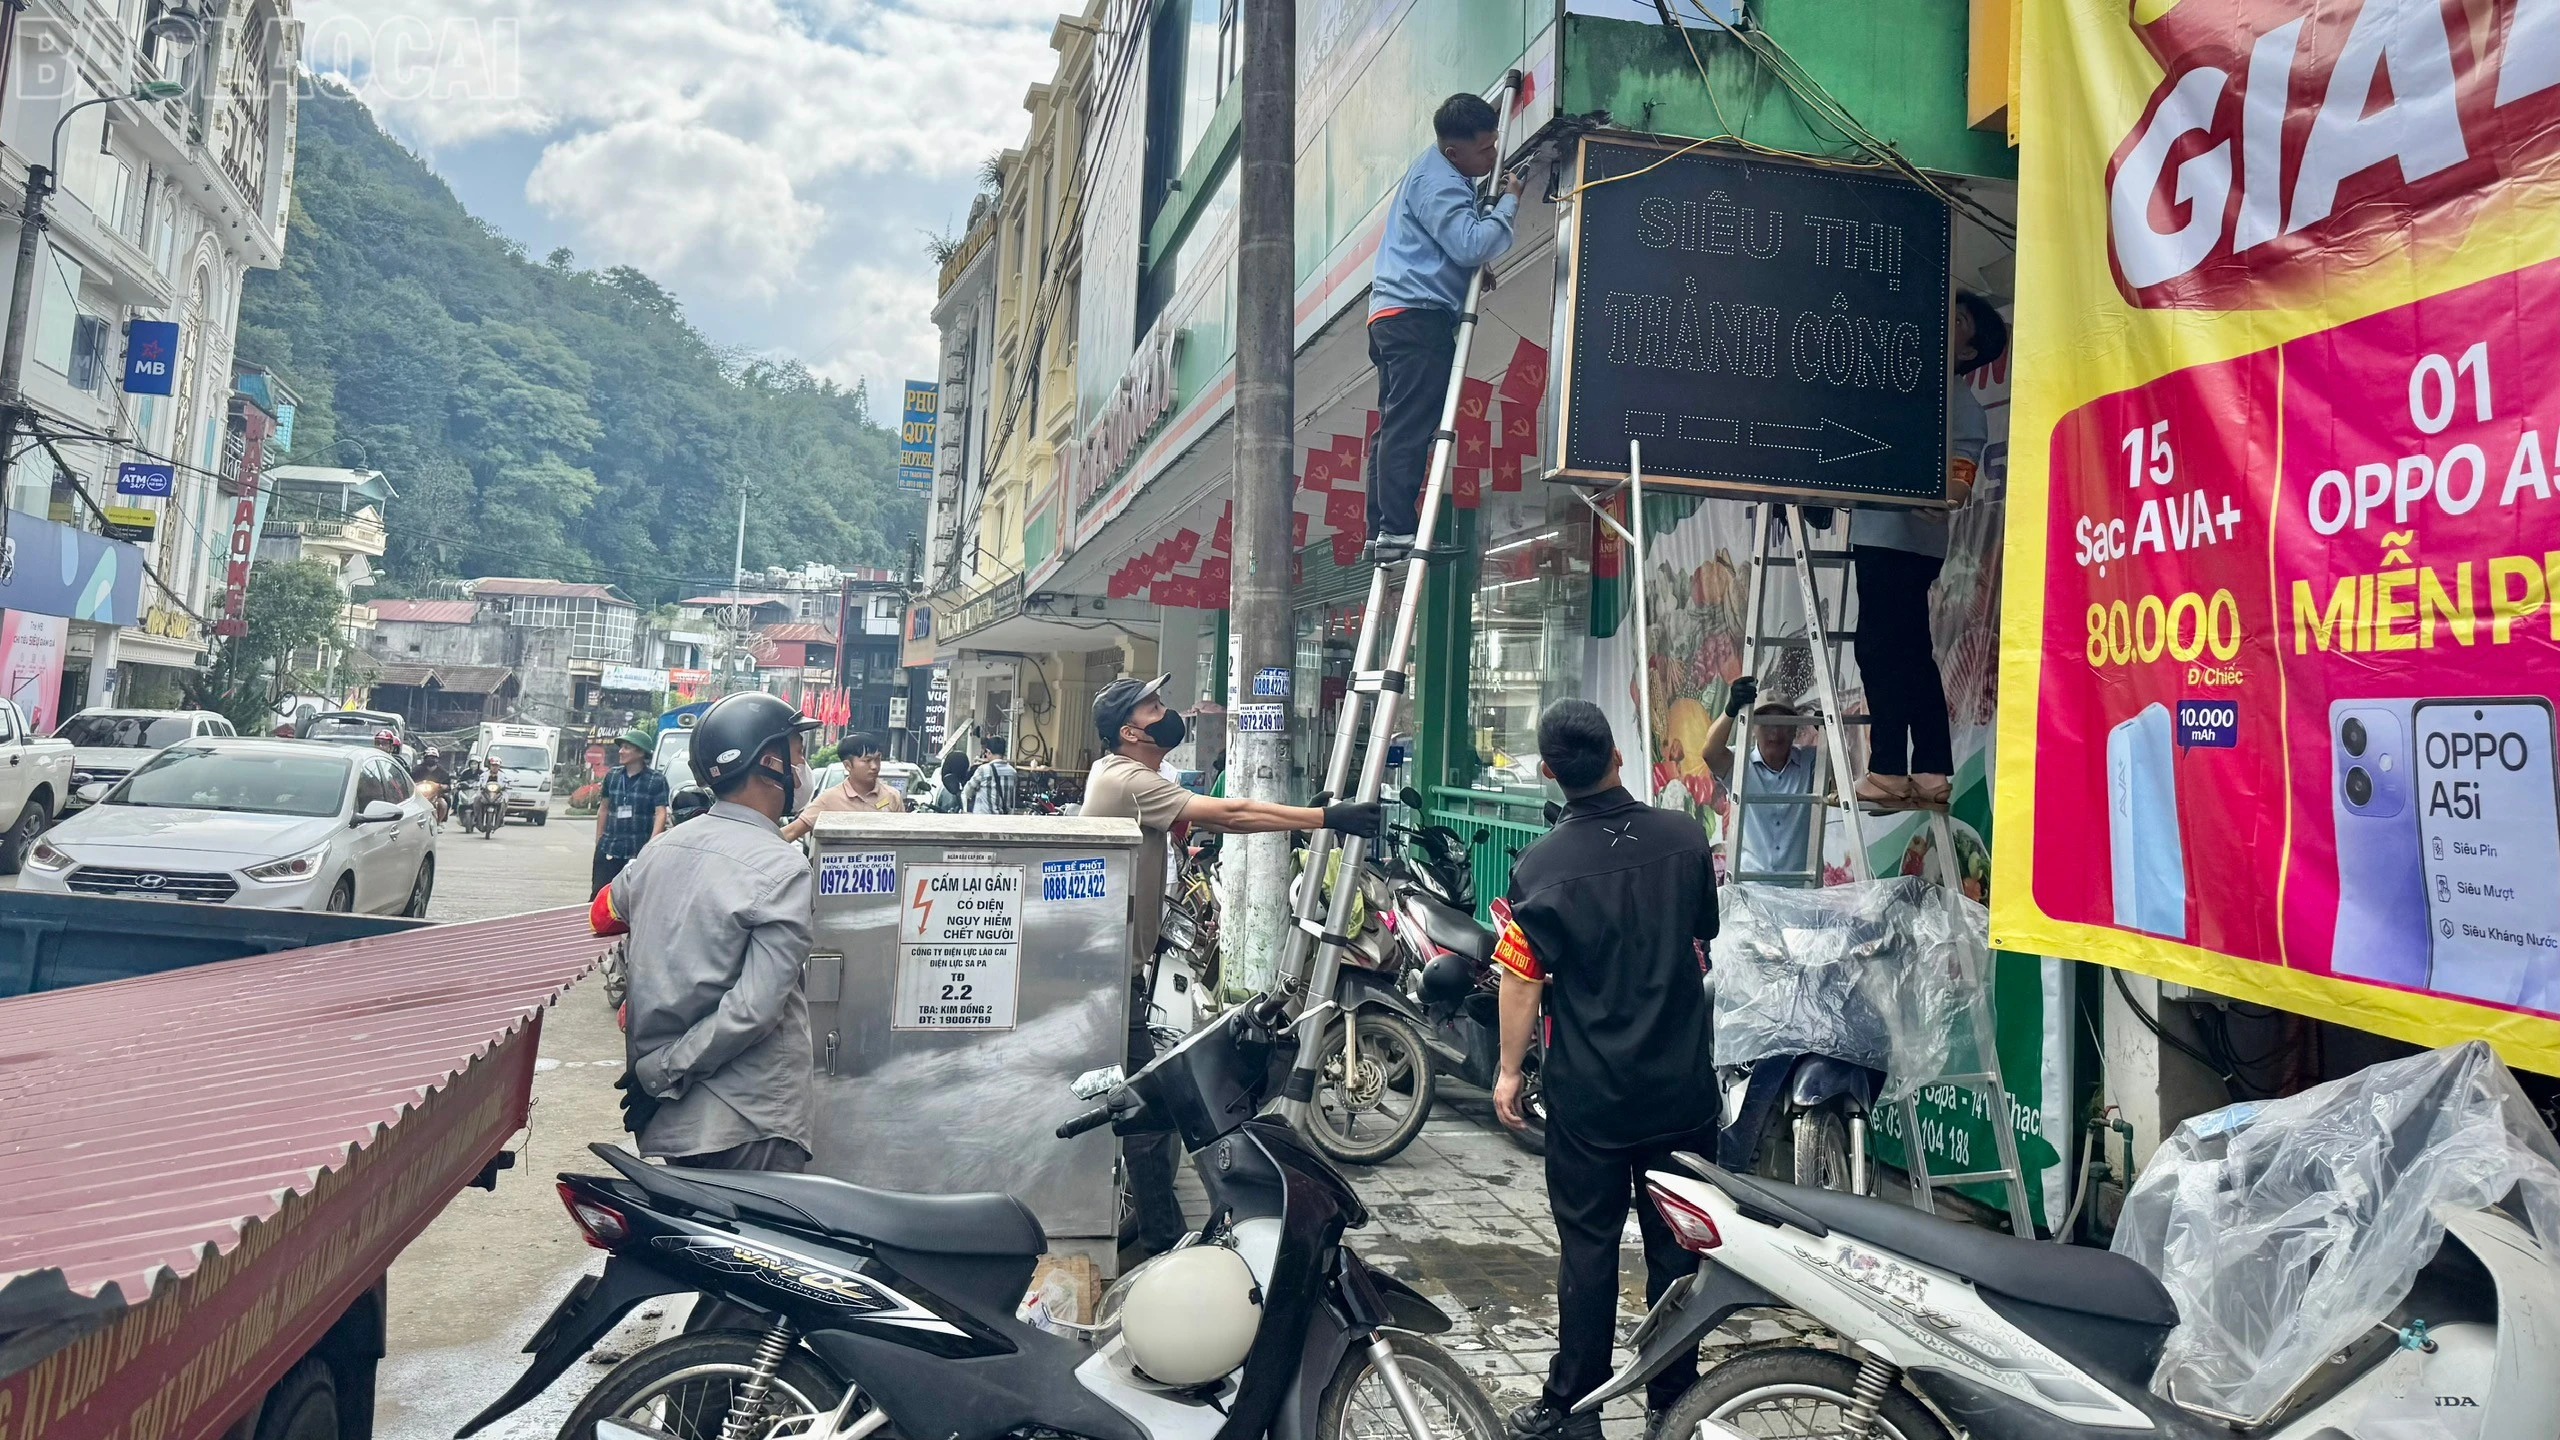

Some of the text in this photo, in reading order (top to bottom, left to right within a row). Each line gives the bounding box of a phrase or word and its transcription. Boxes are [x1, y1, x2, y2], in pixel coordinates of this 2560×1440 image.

[1637, 190, 1902, 292] SIÊU THỊ
[1790, 292, 1923, 392] CÔNG
[135, 360, 165, 376] MB
[2408, 341, 2494, 435] 01
[905, 386, 937, 414] PHÚ
[902, 418, 936, 445] QUÝ
[900, 451, 933, 467] HOTEL
[2121, 419, 2174, 489] 15
[121, 474, 147, 484] ATM
[2308, 429, 2560, 536] OPPO A
[2075, 489, 2242, 578] Sạc AVA+
[2292, 529, 2475, 656] MIỄN
[2086, 587, 2240, 667] 80.000
[2188, 663, 2244, 687] Đ/Chiếc
[2179, 708, 2234, 729] 10.000
[2191, 728, 2217, 742] mAh
[2425, 731, 2528, 771] OPPO
[2429, 780, 2481, 820] A5i
[822, 855, 844, 863] HÚT
[2453, 842, 2498, 858] Siêu Pin
[1045, 864, 1061, 873] HÚT
[821, 868, 895, 895] 0972.249.100
[931, 872, 959, 892] CẤM
[962, 878, 985, 895] LẠI
[1043, 875, 1106, 901] 0888.422.422
[2457, 881, 2515, 901] Siêu Mượt
[957, 898, 1004, 911] CÓ ĐIỆN
[947, 911, 1012, 927] NGUY HIỂM
[944, 924, 1014, 941] CHẾT NGƯỜI
[2462, 924, 2558, 950] Siêu Kháng Nước
[911, 945, 1007, 958] CÔNG TY ĐIỆN LỰC LÀO CAI
[929, 957, 987, 969] ĐIỆN LỰC SA PA
[941, 984, 972, 1001] 2.2
[919, 1002, 992, 1014] TBA: KIM ĐỒNG 2
[1948, 1126, 1970, 1166] 188
